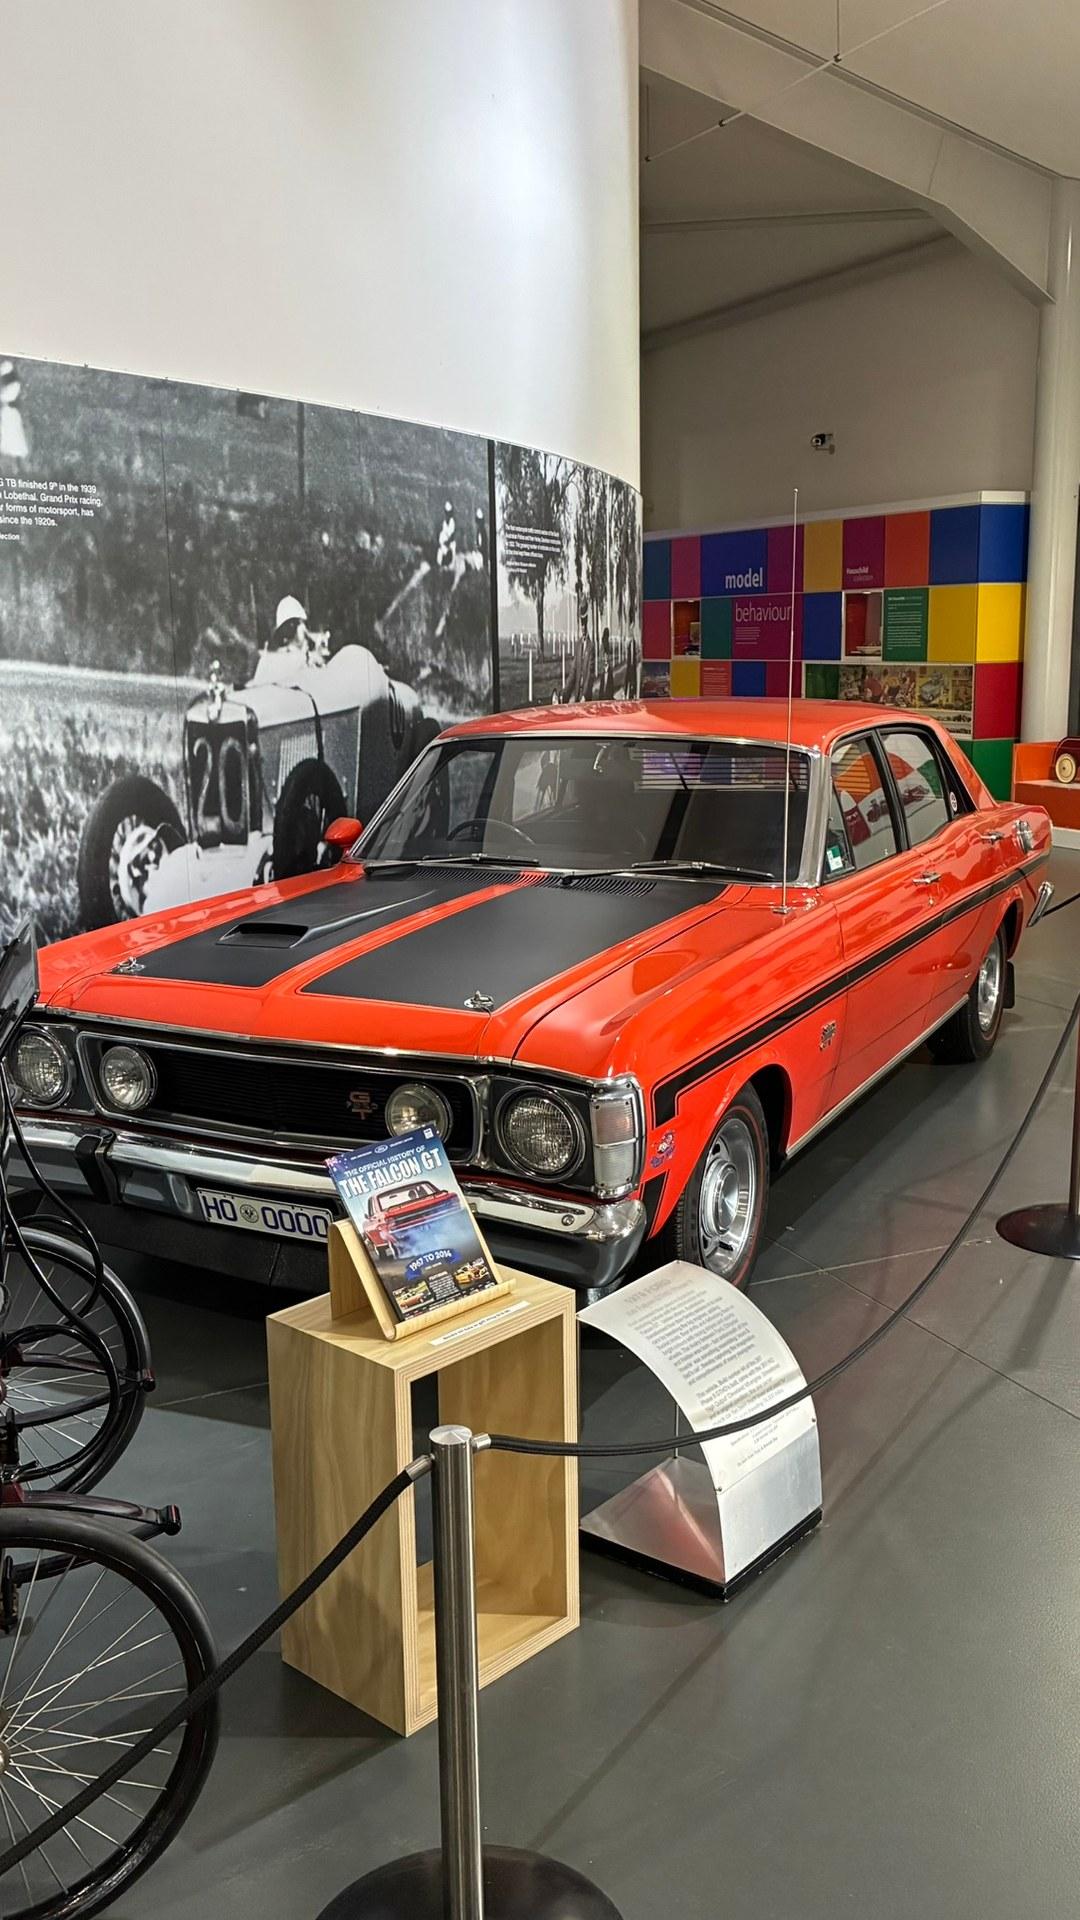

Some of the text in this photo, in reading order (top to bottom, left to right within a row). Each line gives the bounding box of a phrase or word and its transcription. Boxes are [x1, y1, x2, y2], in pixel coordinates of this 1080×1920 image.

[5, 478, 17, 487] TB
[18, 479, 48, 490] finished
[59, 482, 66, 491] in
[67, 483, 79, 492] the
[80, 484, 97, 493] 1939
[40, 493, 63, 503] Grand
[64, 494, 78, 504] Prix
[6, 503, 28, 513] forms
[29, 504, 37, 513] of
[38, 505, 80, 517] motorsport,
[81, 508, 94, 517] has
[20, 516, 33, 526] the
[725, 567, 763, 590] model
[735, 600, 792, 622] behaviour
[344, 1168, 359, 1178] THE
[359, 1159, 388, 1173] OFFICIAL
[387, 1148, 415, 1164] HISTORY
[416, 1144, 426, 1154] OF
[339, 1148, 442, 1199] THE FALCON GT
[409, 1257, 424, 1272] 1967
[423, 1253, 435, 1263] TO
